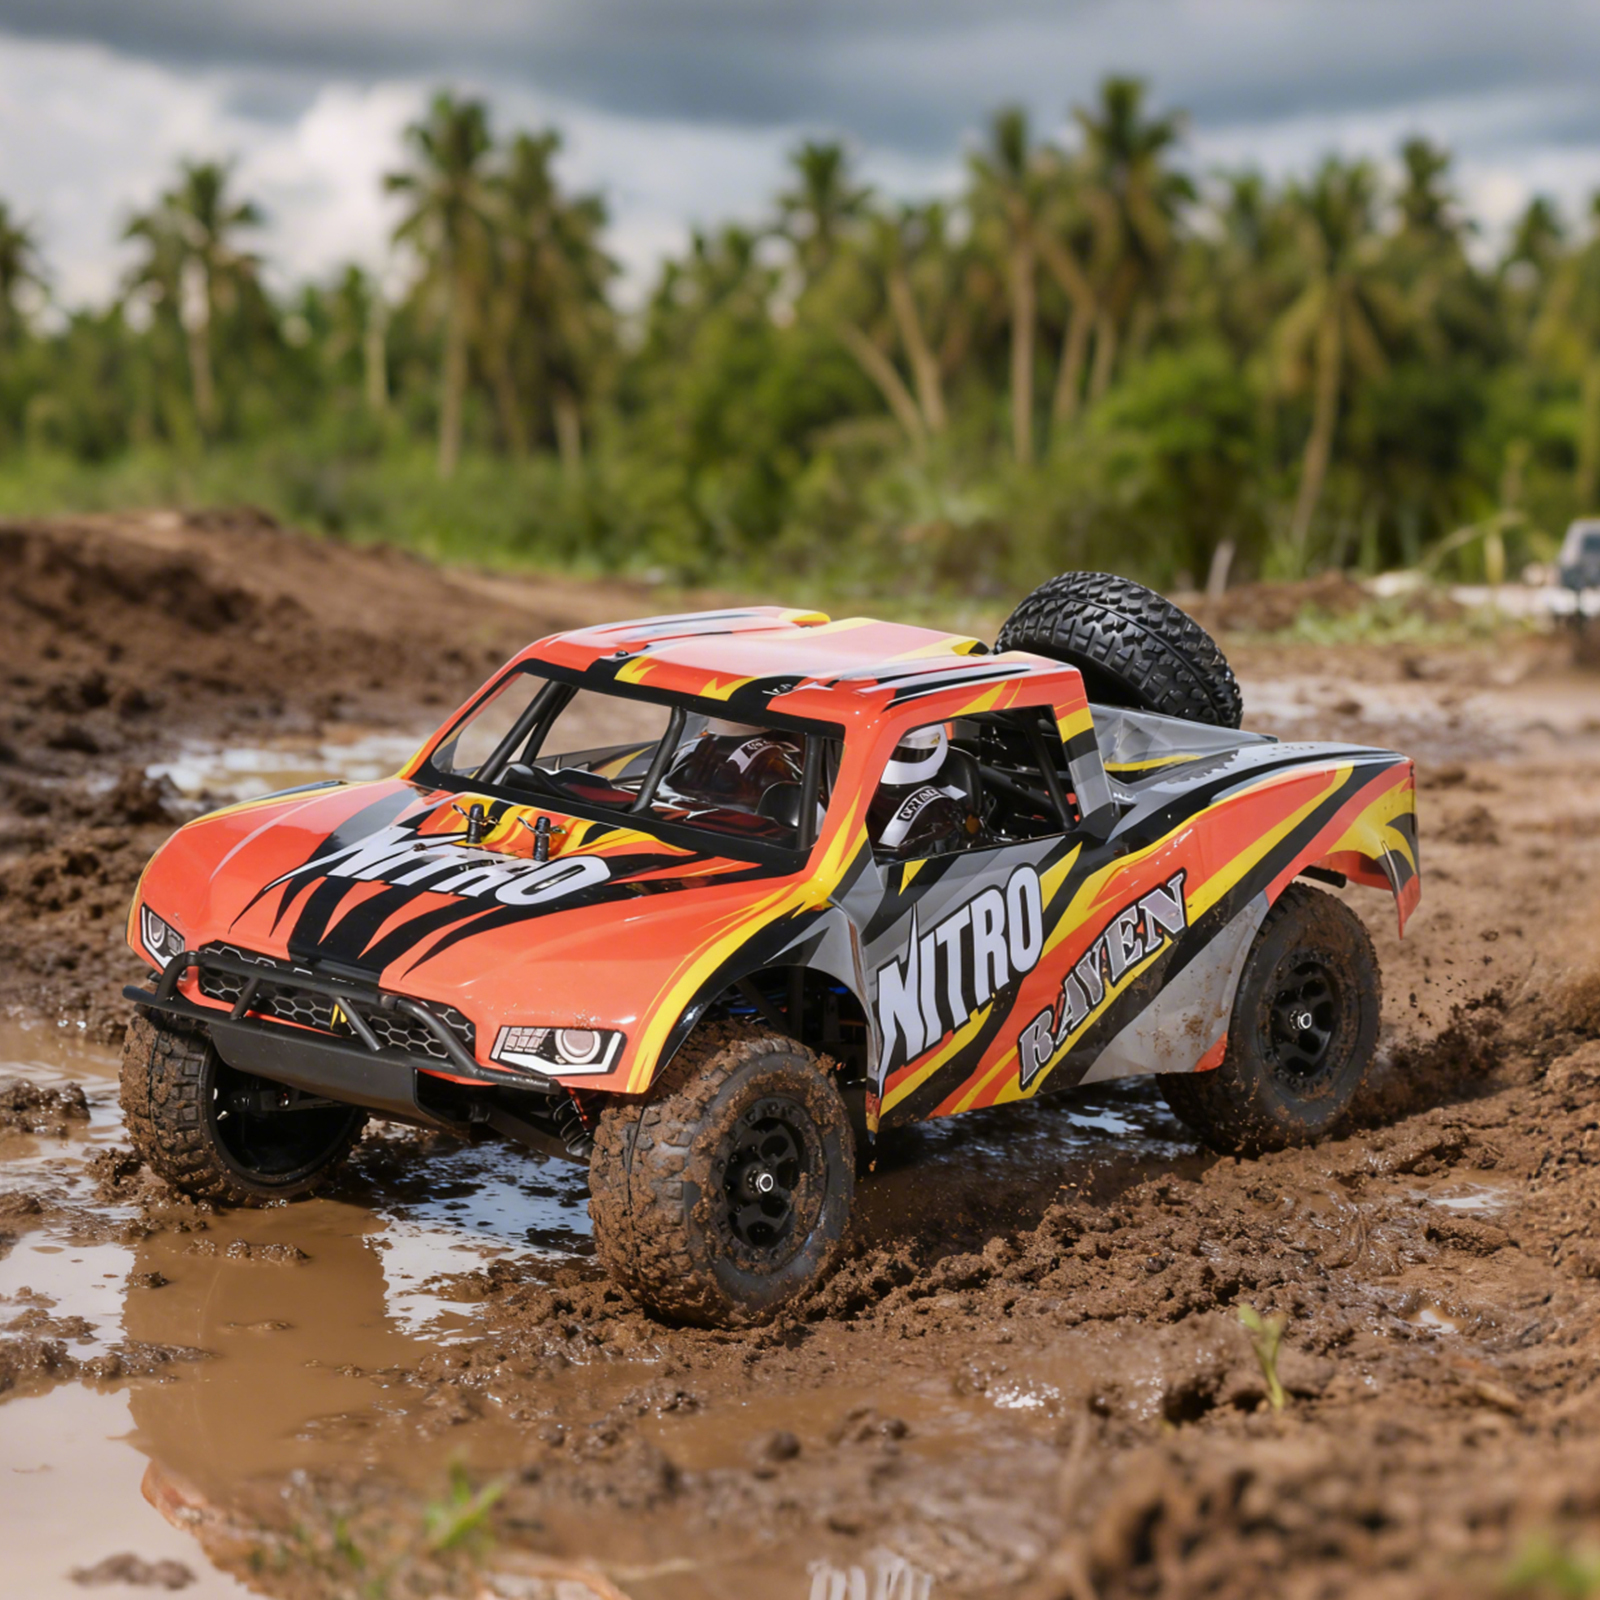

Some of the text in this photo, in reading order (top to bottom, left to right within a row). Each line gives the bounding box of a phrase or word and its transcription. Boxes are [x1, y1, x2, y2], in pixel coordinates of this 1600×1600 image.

[268, 826, 612, 905] NITRO
[877, 865, 1044, 1099] NITRO
[1019, 871, 1188, 1087] RAVEN
